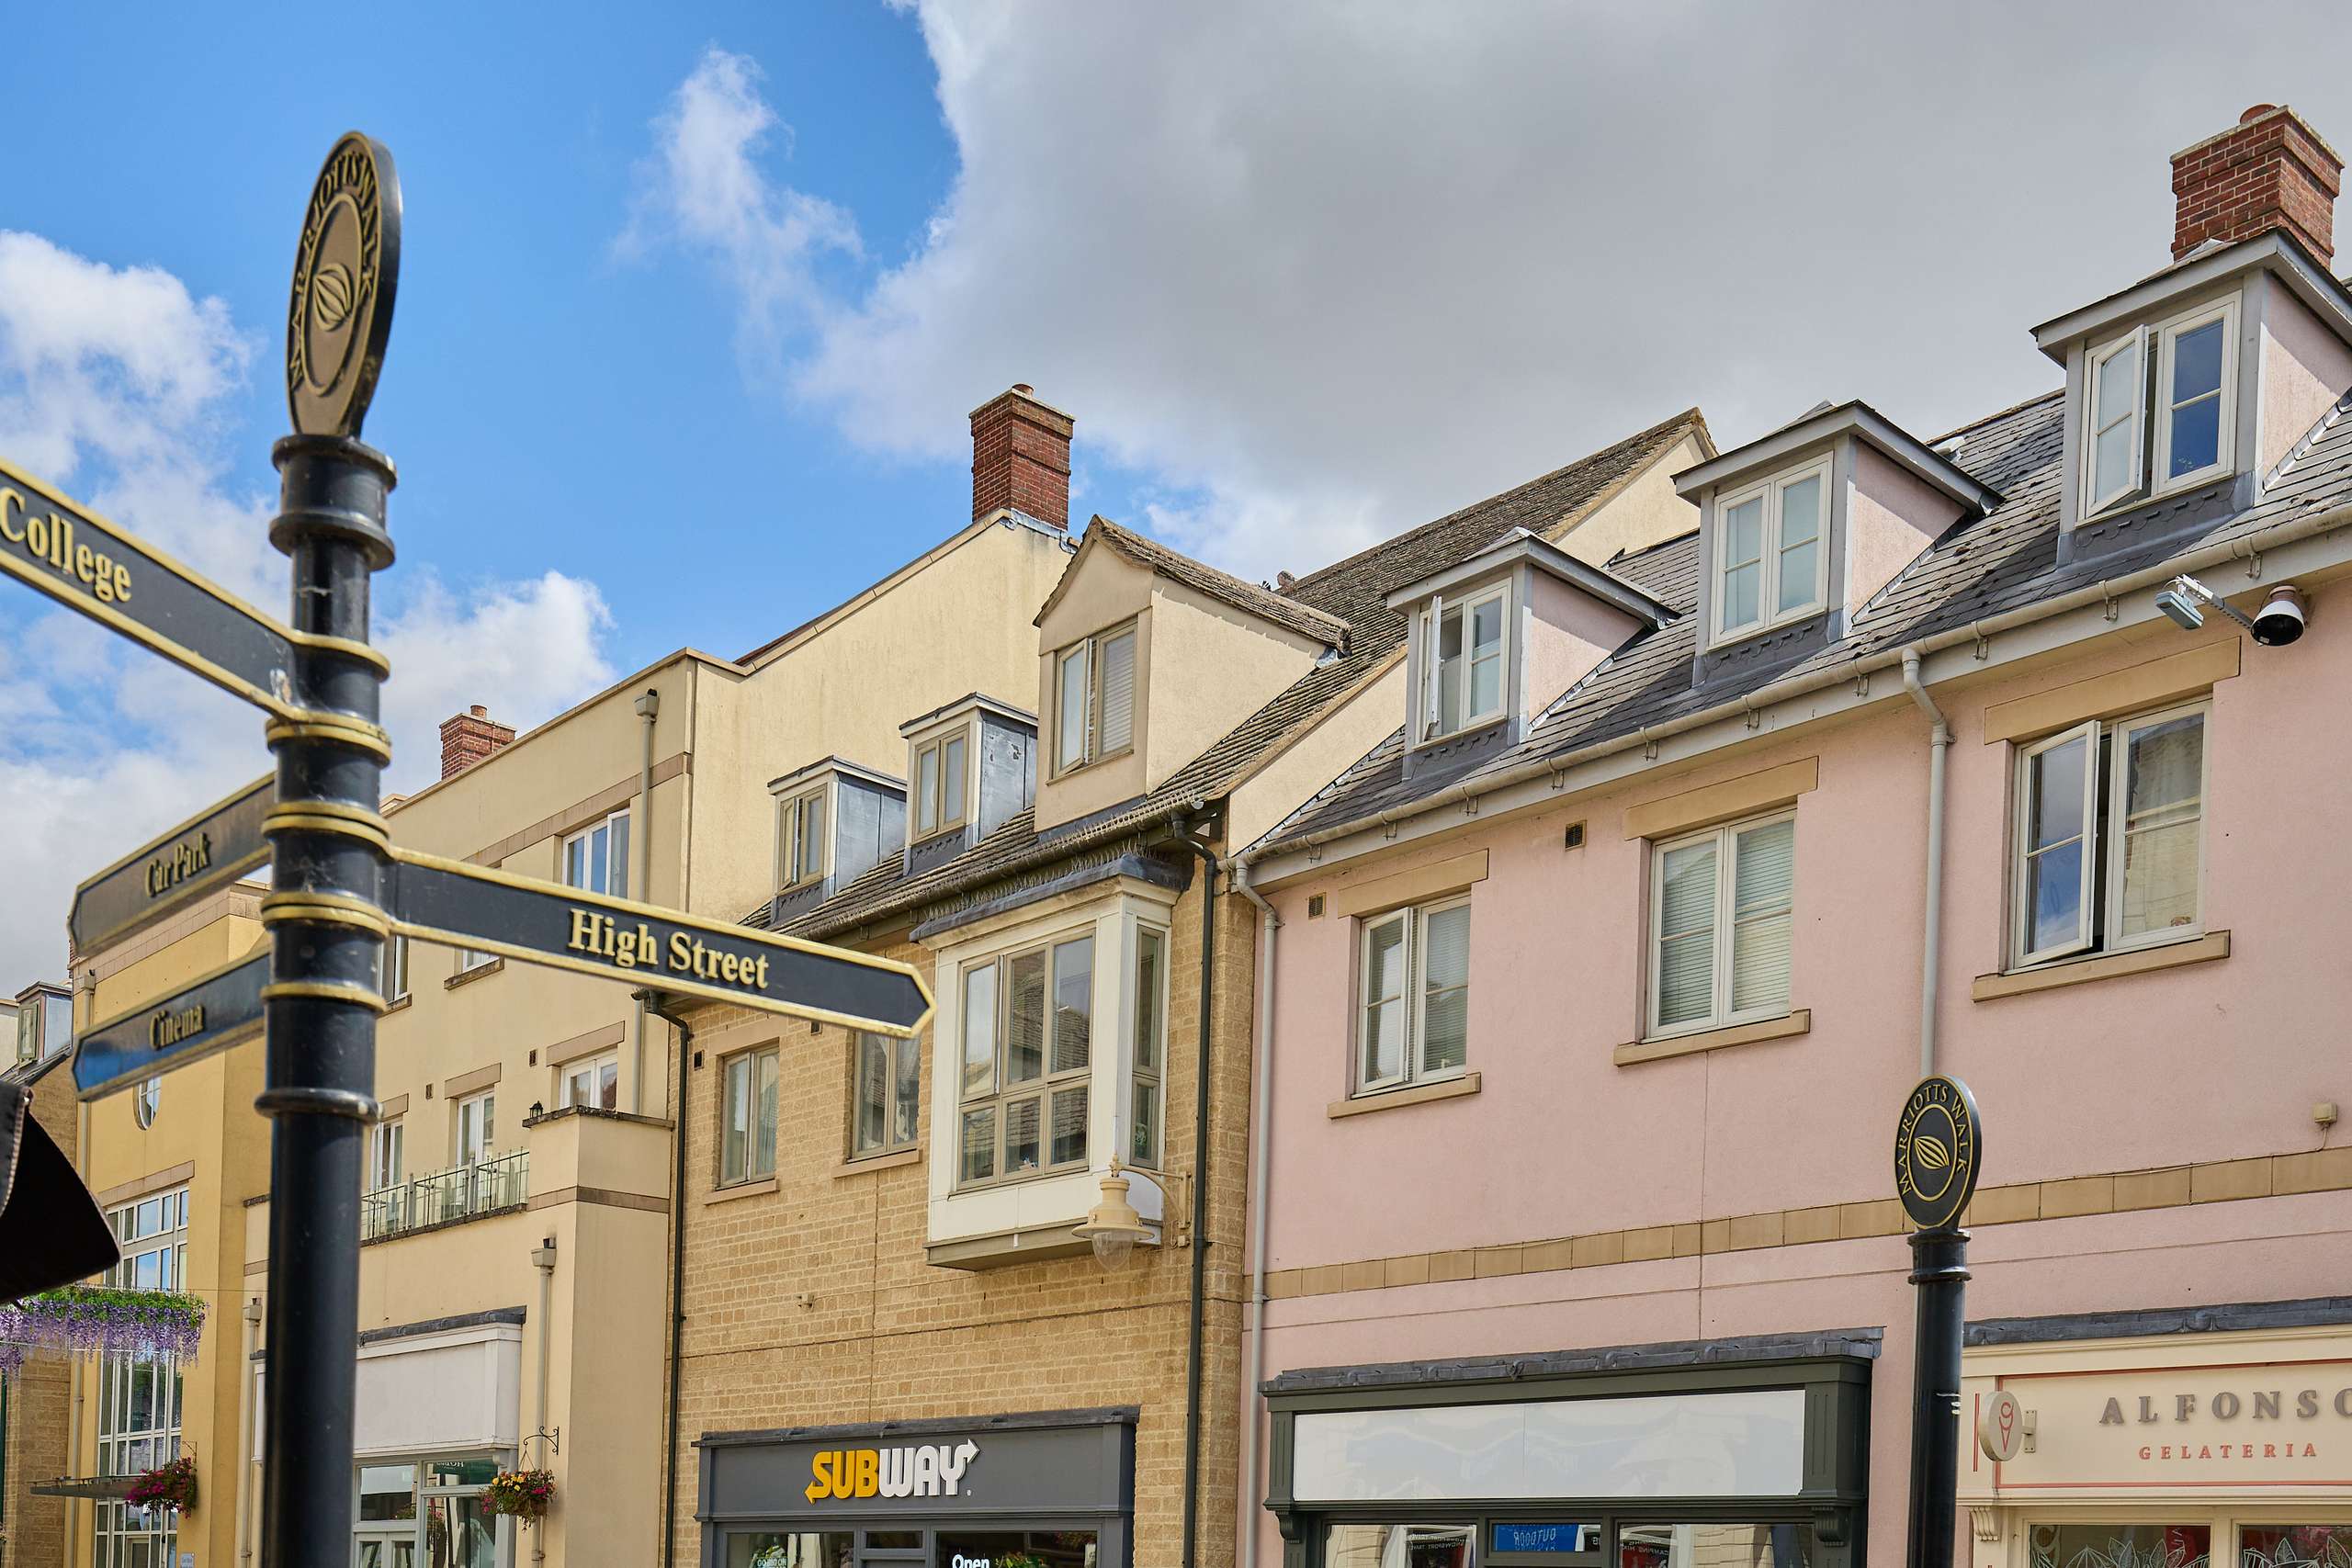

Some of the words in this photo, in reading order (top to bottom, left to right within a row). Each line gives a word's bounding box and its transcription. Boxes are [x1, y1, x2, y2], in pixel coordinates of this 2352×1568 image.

[290, 151, 359, 389] MARRIOTTS
[357, 157, 379, 304] WALK
[0, 486, 132, 603] College
[145, 857, 174, 898] Car
[174, 832, 212, 884] Park
[567, 908, 659, 968] High
[669, 931, 769, 989] Street
[149, 1003, 205, 1051] Cinema
[1898, 1084, 1950, 1196] MARRIOTTS
[1951, 1094, 1969, 1175] WALK
[804, 1438, 980, 1505] SUBWAY
[2140, 1443, 2317, 1460] GELATERIA
